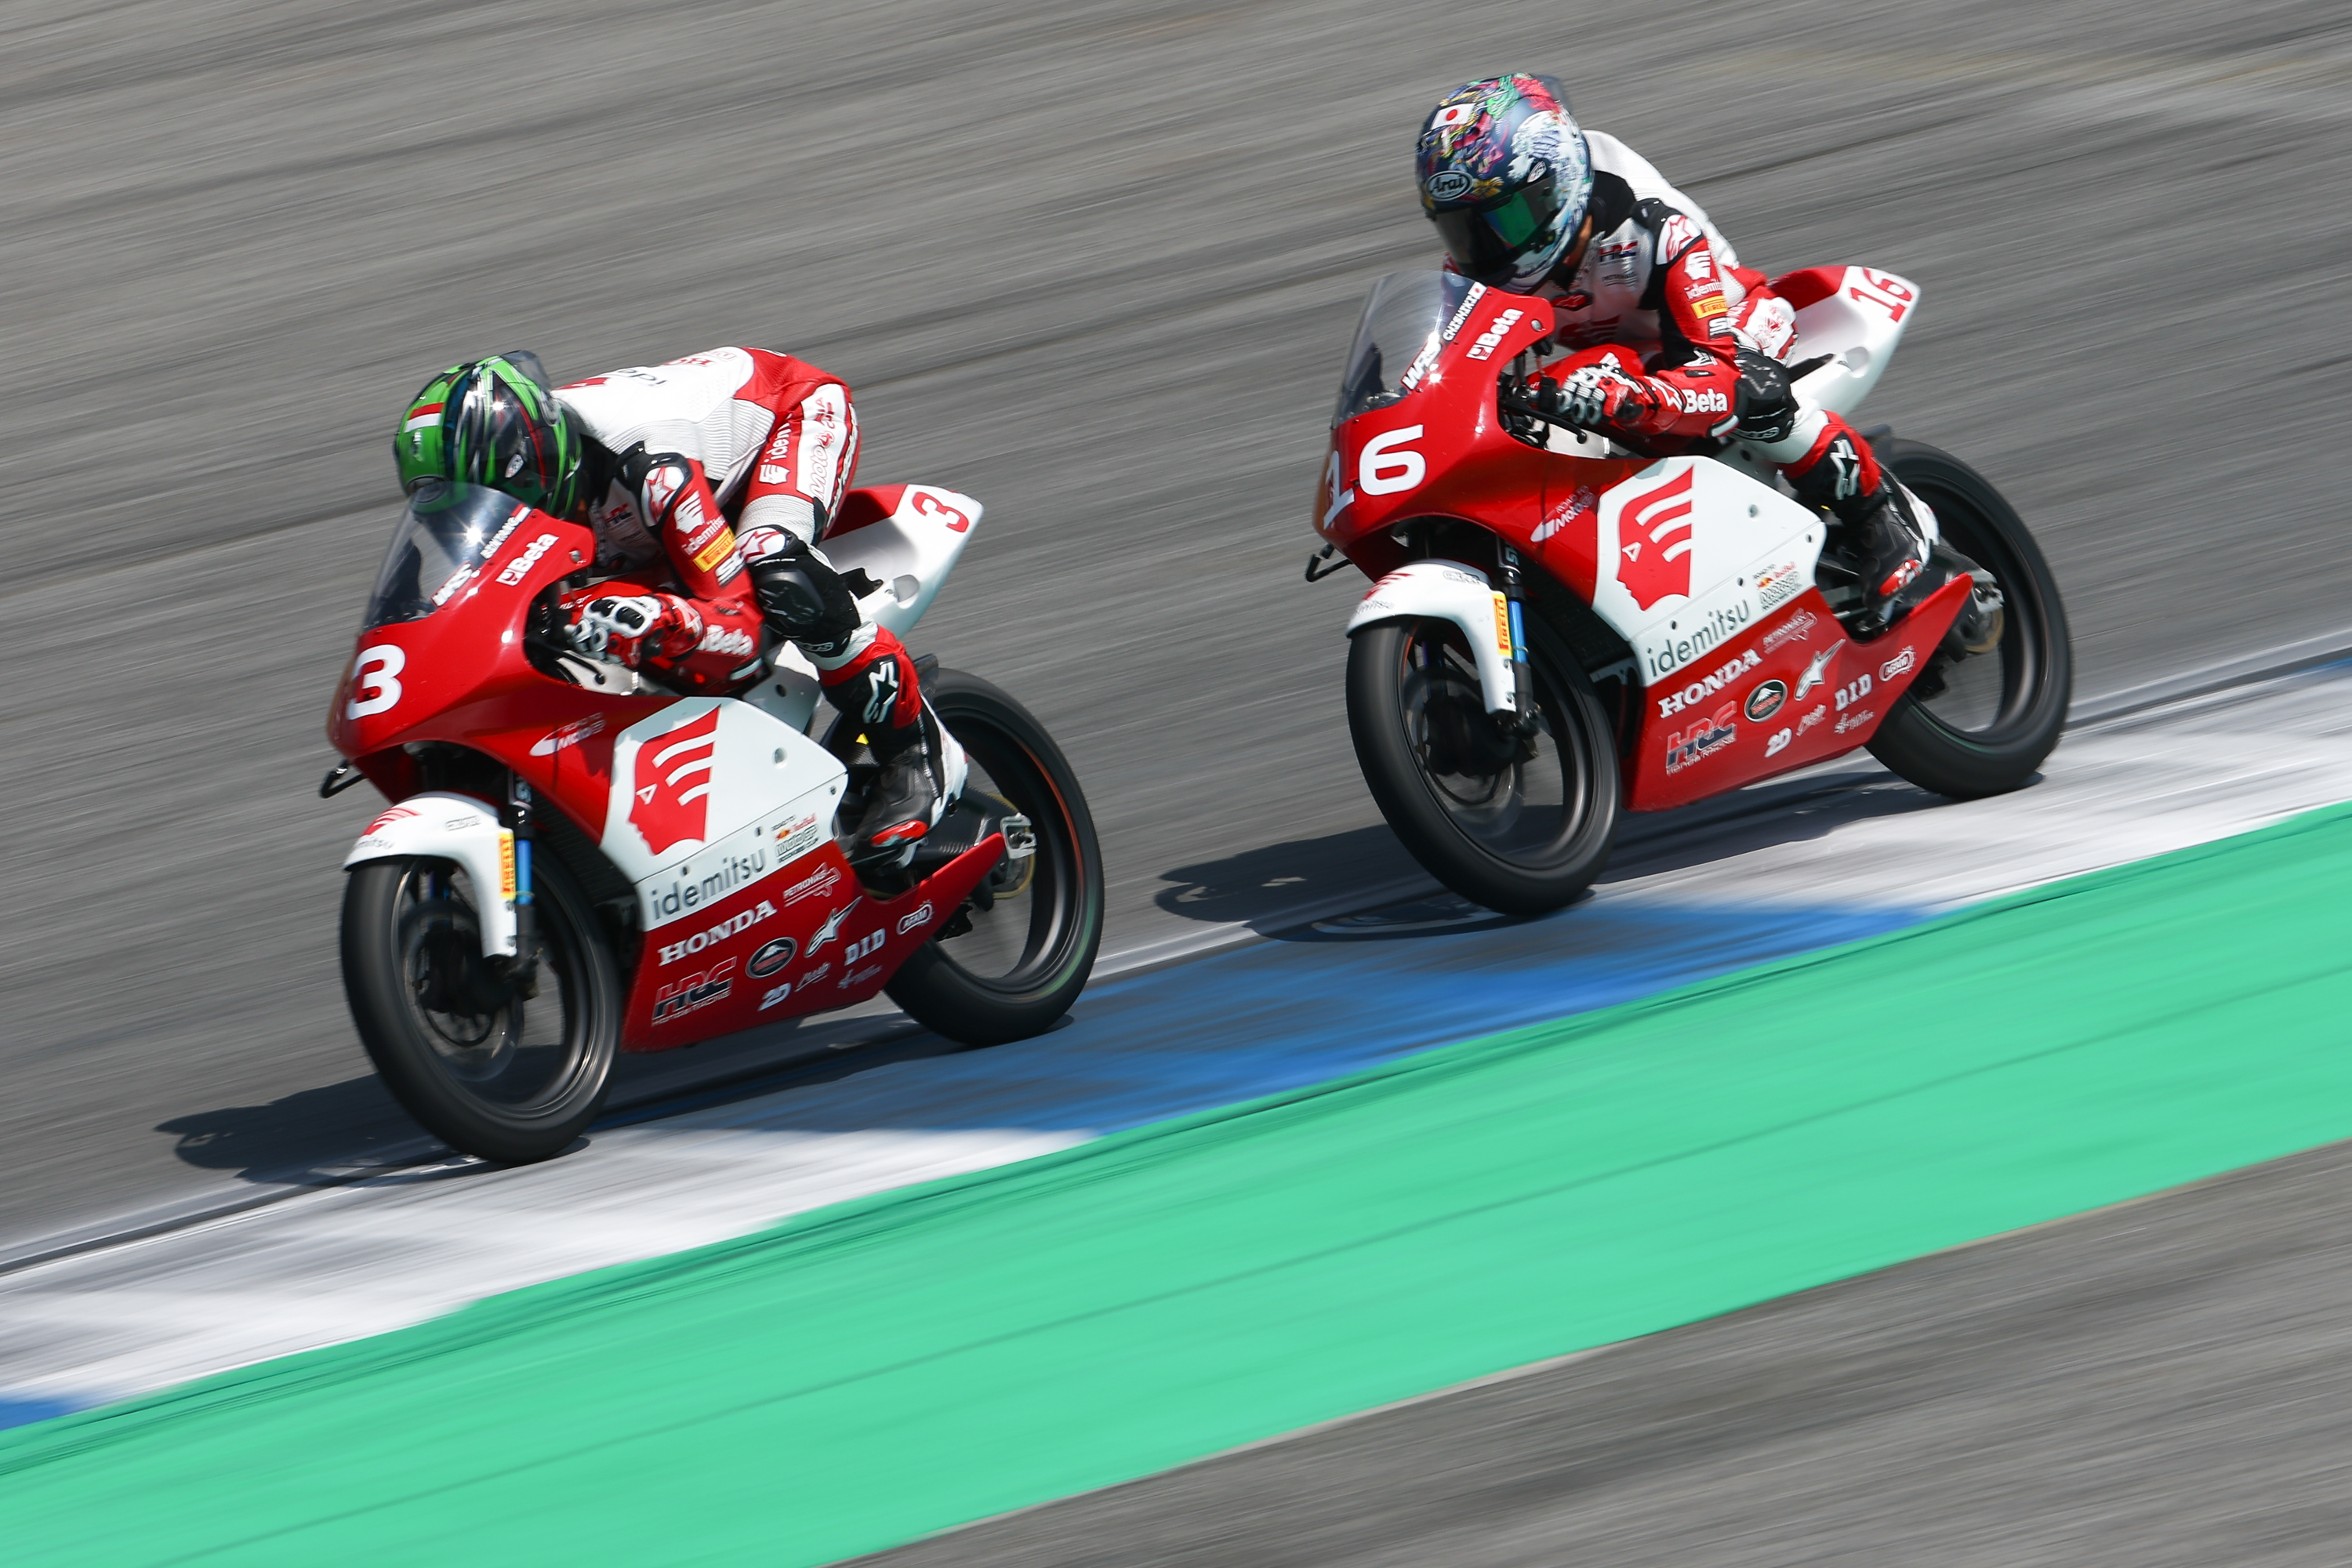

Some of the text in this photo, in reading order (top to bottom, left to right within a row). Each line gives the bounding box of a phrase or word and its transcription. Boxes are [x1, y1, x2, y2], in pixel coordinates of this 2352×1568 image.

[1429, 174, 1466, 194] Arai
[1850, 267, 1913, 324] 16
[1475, 308, 1525, 347] Beta
[1683, 387, 1728, 414] Beta
[1323, 423, 1427, 530] 16
[912, 491, 969, 533] 3
[506, 533, 560, 573] Beta
[1494, 597, 1510, 650] PIRELLI
[1646, 599, 1750, 677] idemitsu
[347, 644, 406, 720] 3
[1658, 648, 1763, 720] HONDA
[1667, 700, 1737, 769] HRC
[651, 848, 765, 920] idemitsu
[782, 867, 827, 898] PETRONAS
[658, 899, 778, 967] HONDA
[652, 956, 738, 1021] HRC
[757, 982, 792, 1012] 2D
